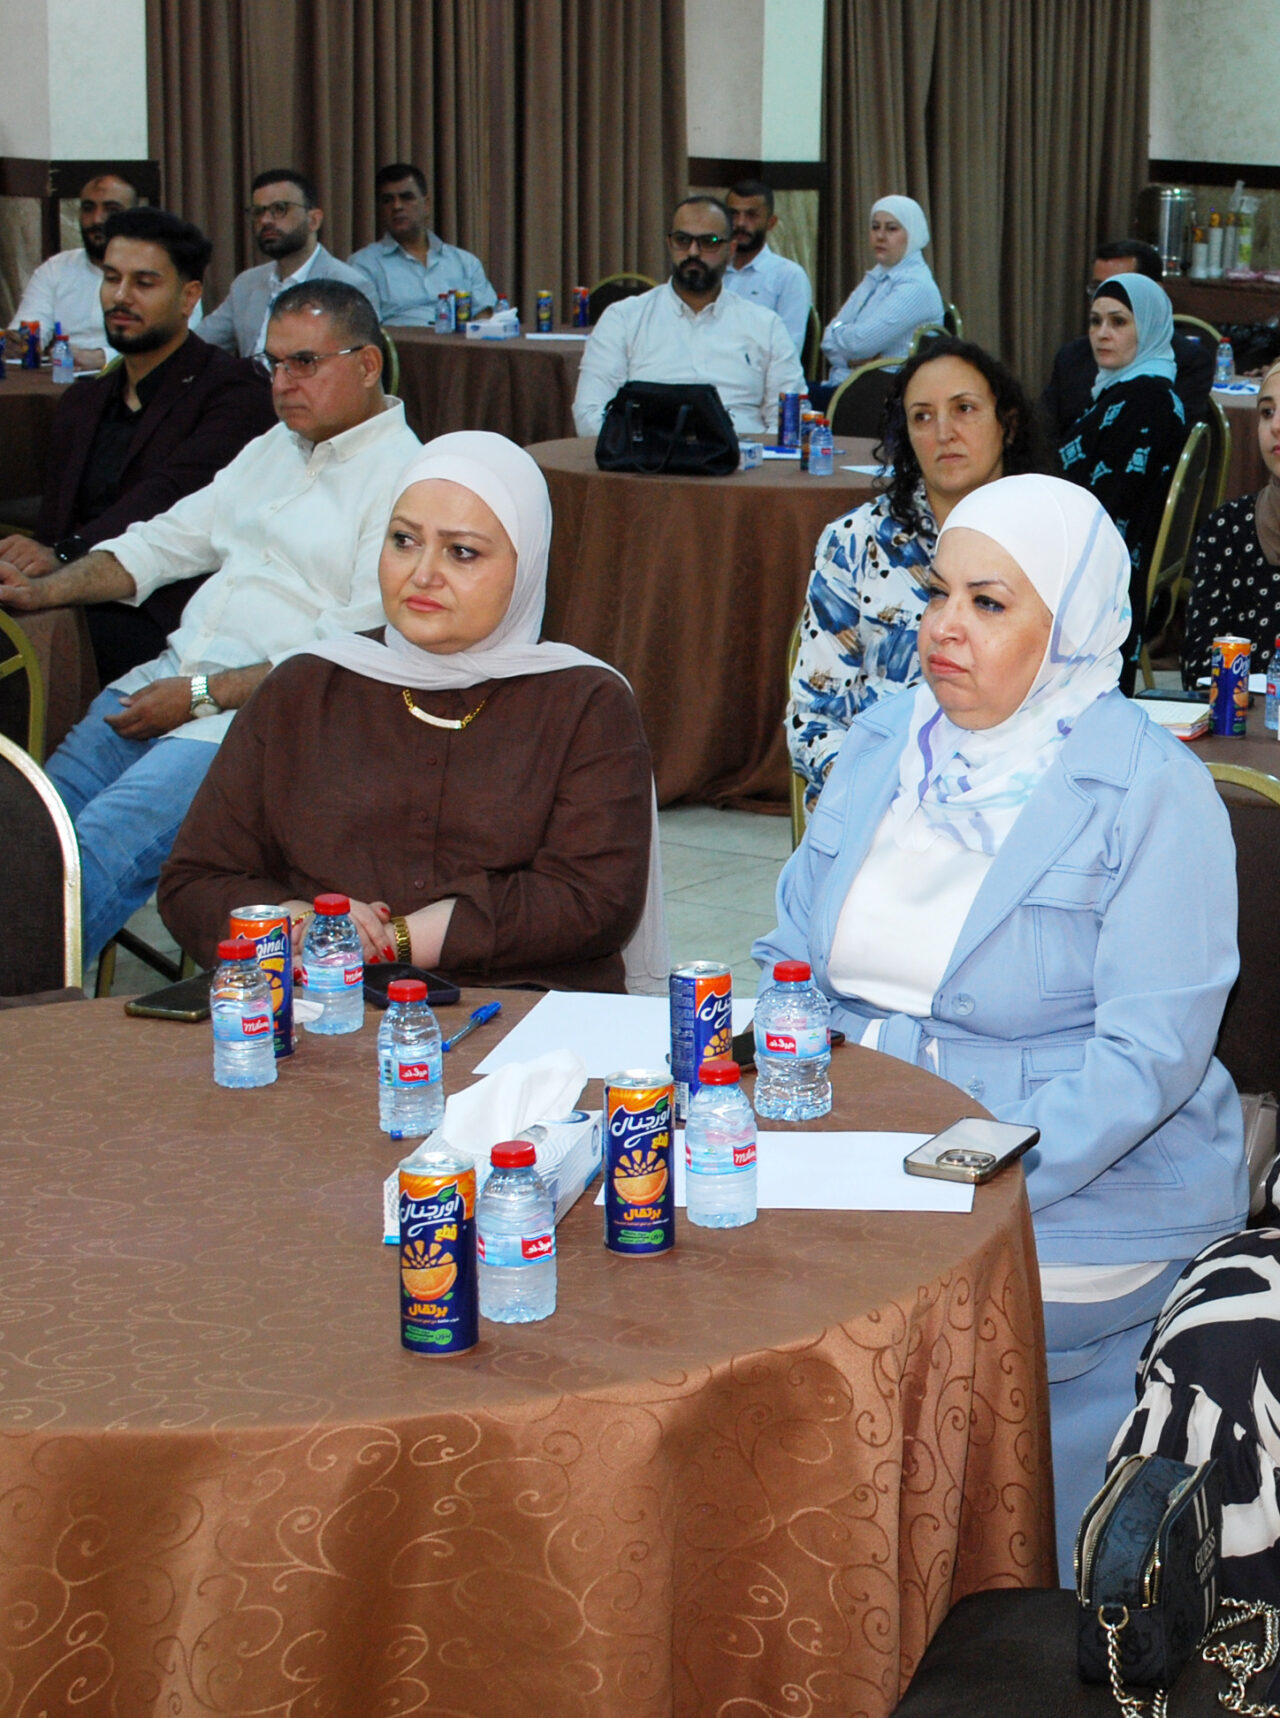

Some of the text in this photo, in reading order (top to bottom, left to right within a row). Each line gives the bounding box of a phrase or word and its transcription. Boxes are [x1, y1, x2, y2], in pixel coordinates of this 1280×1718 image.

[256, 934, 285, 962] ginal
[623, 1206, 663, 1221] برتقال
[408, 1303, 449, 1318] برتقال
